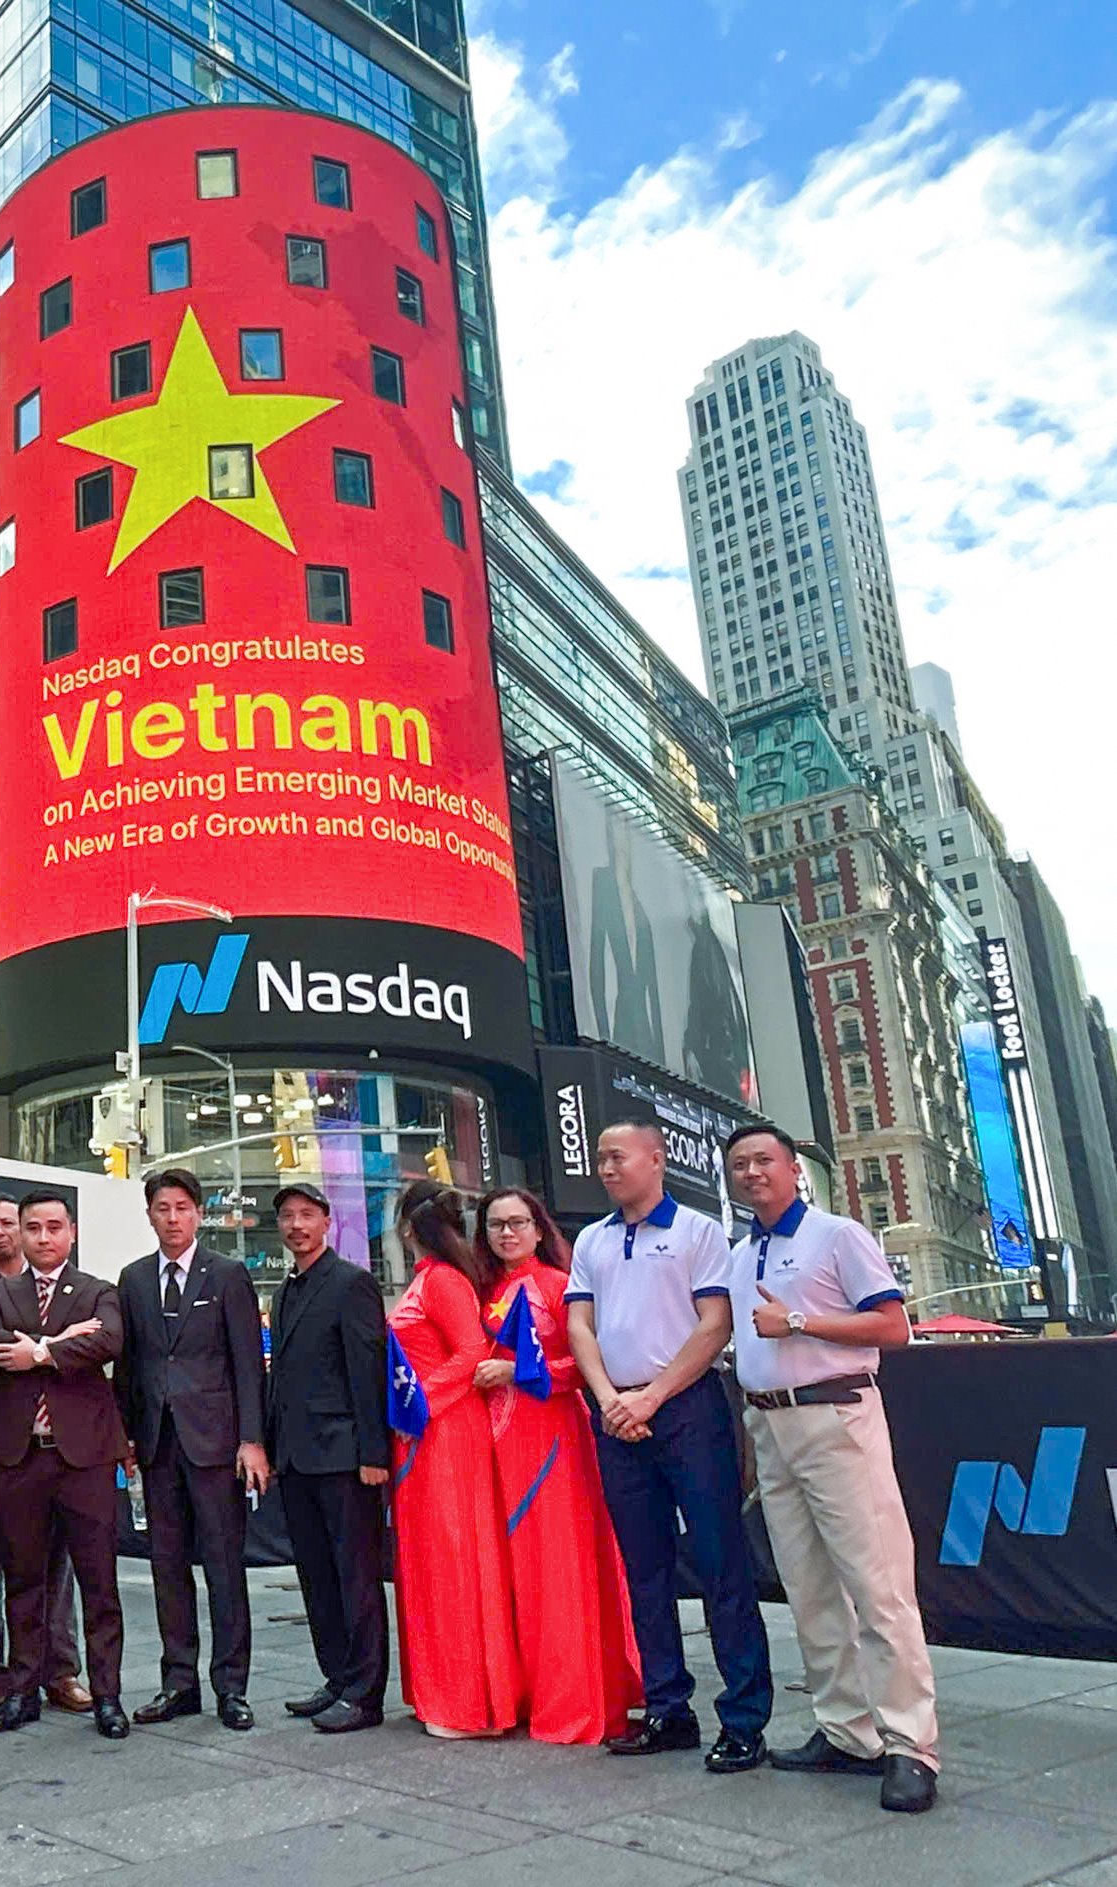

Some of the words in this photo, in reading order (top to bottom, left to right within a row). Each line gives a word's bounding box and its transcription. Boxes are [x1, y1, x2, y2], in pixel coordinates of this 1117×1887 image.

[42, 654, 141, 700] Nasdaq
[149, 635, 366, 668] Congratulates
[42, 683, 433, 780] Vietnam
[43, 801, 73, 826] on
[80, 770, 227, 816] Achieving
[235, 766, 382, 804] Emerging
[388, 774, 469, 819] Market
[43, 844, 59, 866] A
[64, 833, 115, 860] New
[122, 824, 164, 848] Era
[170, 813, 198, 840] of
[205, 811, 309, 837] Growth
[315, 815, 365, 836] and
[370, 816, 441, 849] Global
[256, 960, 473, 1040] Nasdaq
[996, 1013, 1025, 1060] Foot
[556, 1084, 584, 1176] LEGORA
[222, 1195, 257, 1207] Nadaq
